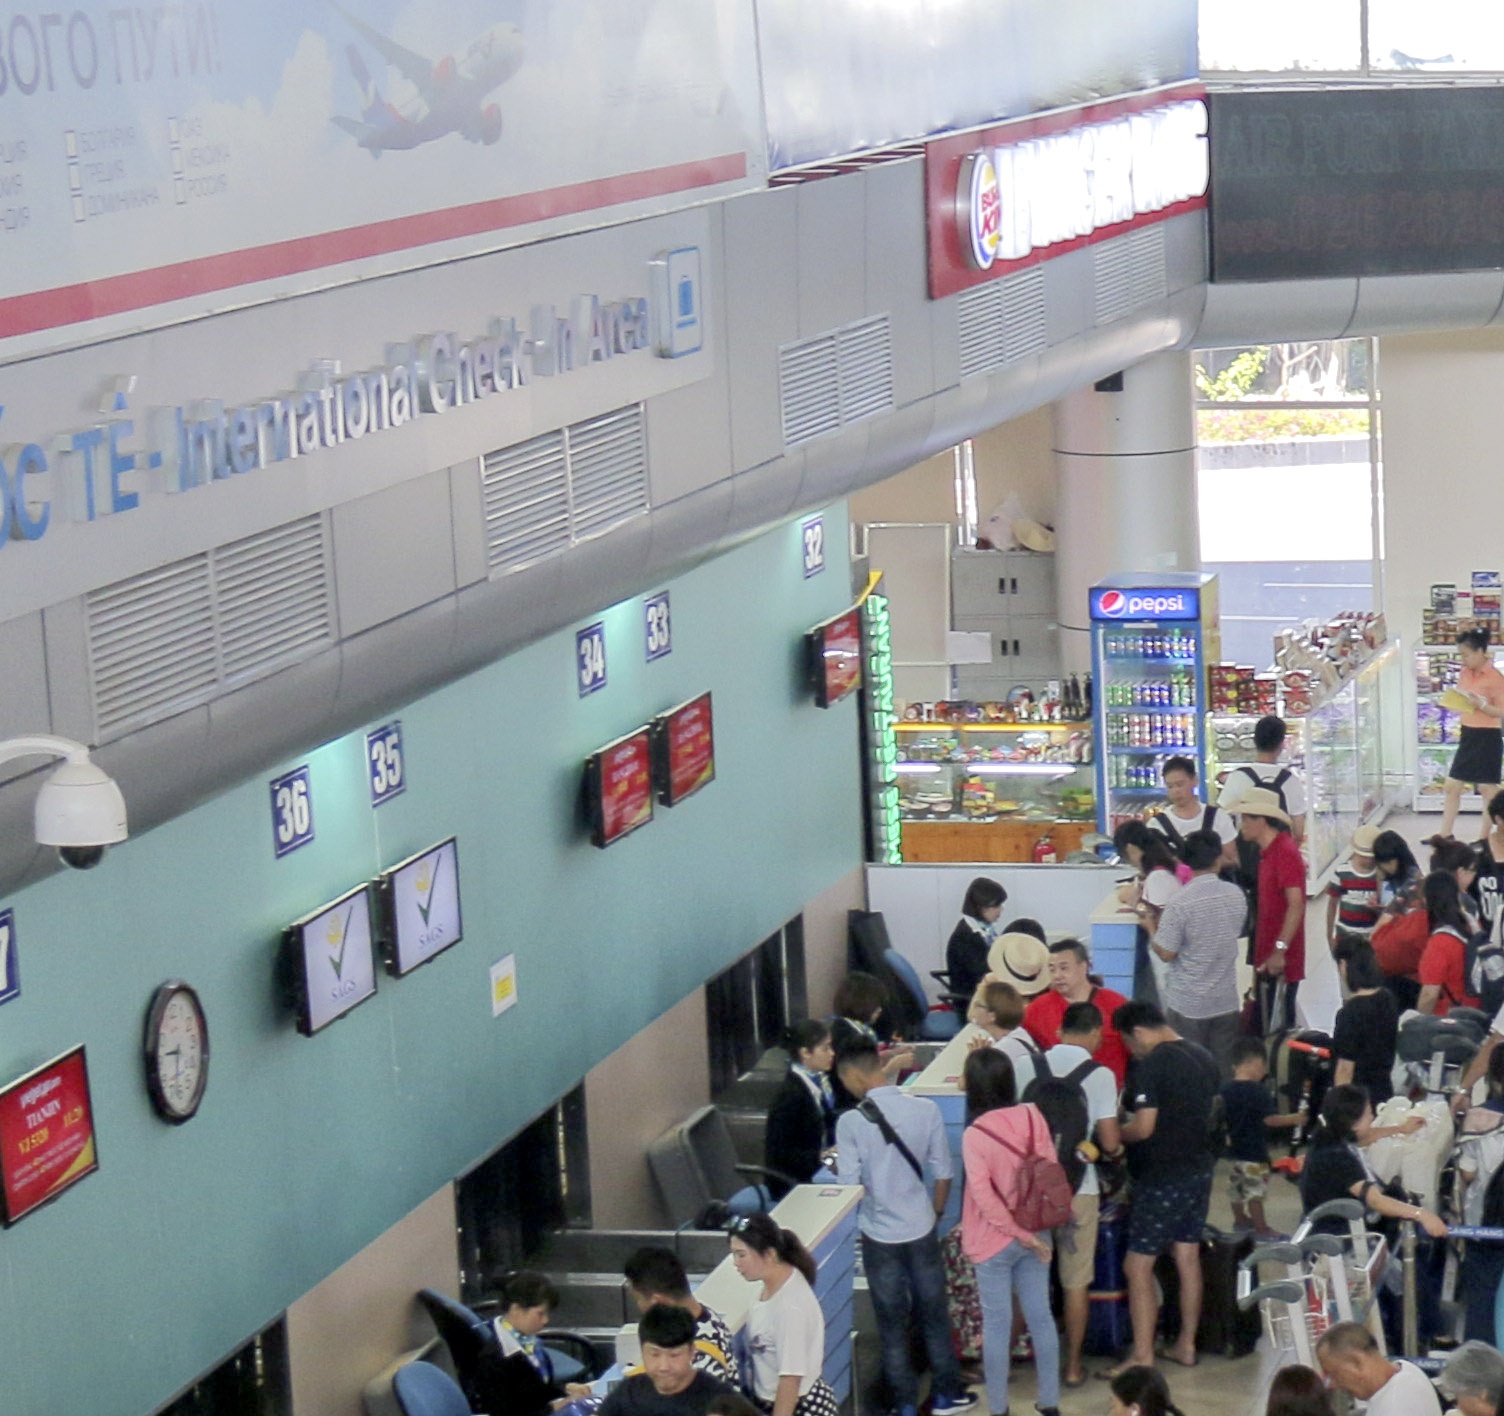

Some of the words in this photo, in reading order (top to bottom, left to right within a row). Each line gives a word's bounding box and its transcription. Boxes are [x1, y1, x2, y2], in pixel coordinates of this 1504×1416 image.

[0, 10, 98, 96] ОГО
[177, 345, 421, 494] International
[804, 524, 823, 570] 32
[647, 601, 670, 652] 33
[1129, 594, 1184, 614] pepsi
[580, 633, 605, 686] 34
[867, 595, 898, 783] RESTAURANT
[371, 733, 402, 795] 35
[276, 779, 311, 844] 36
